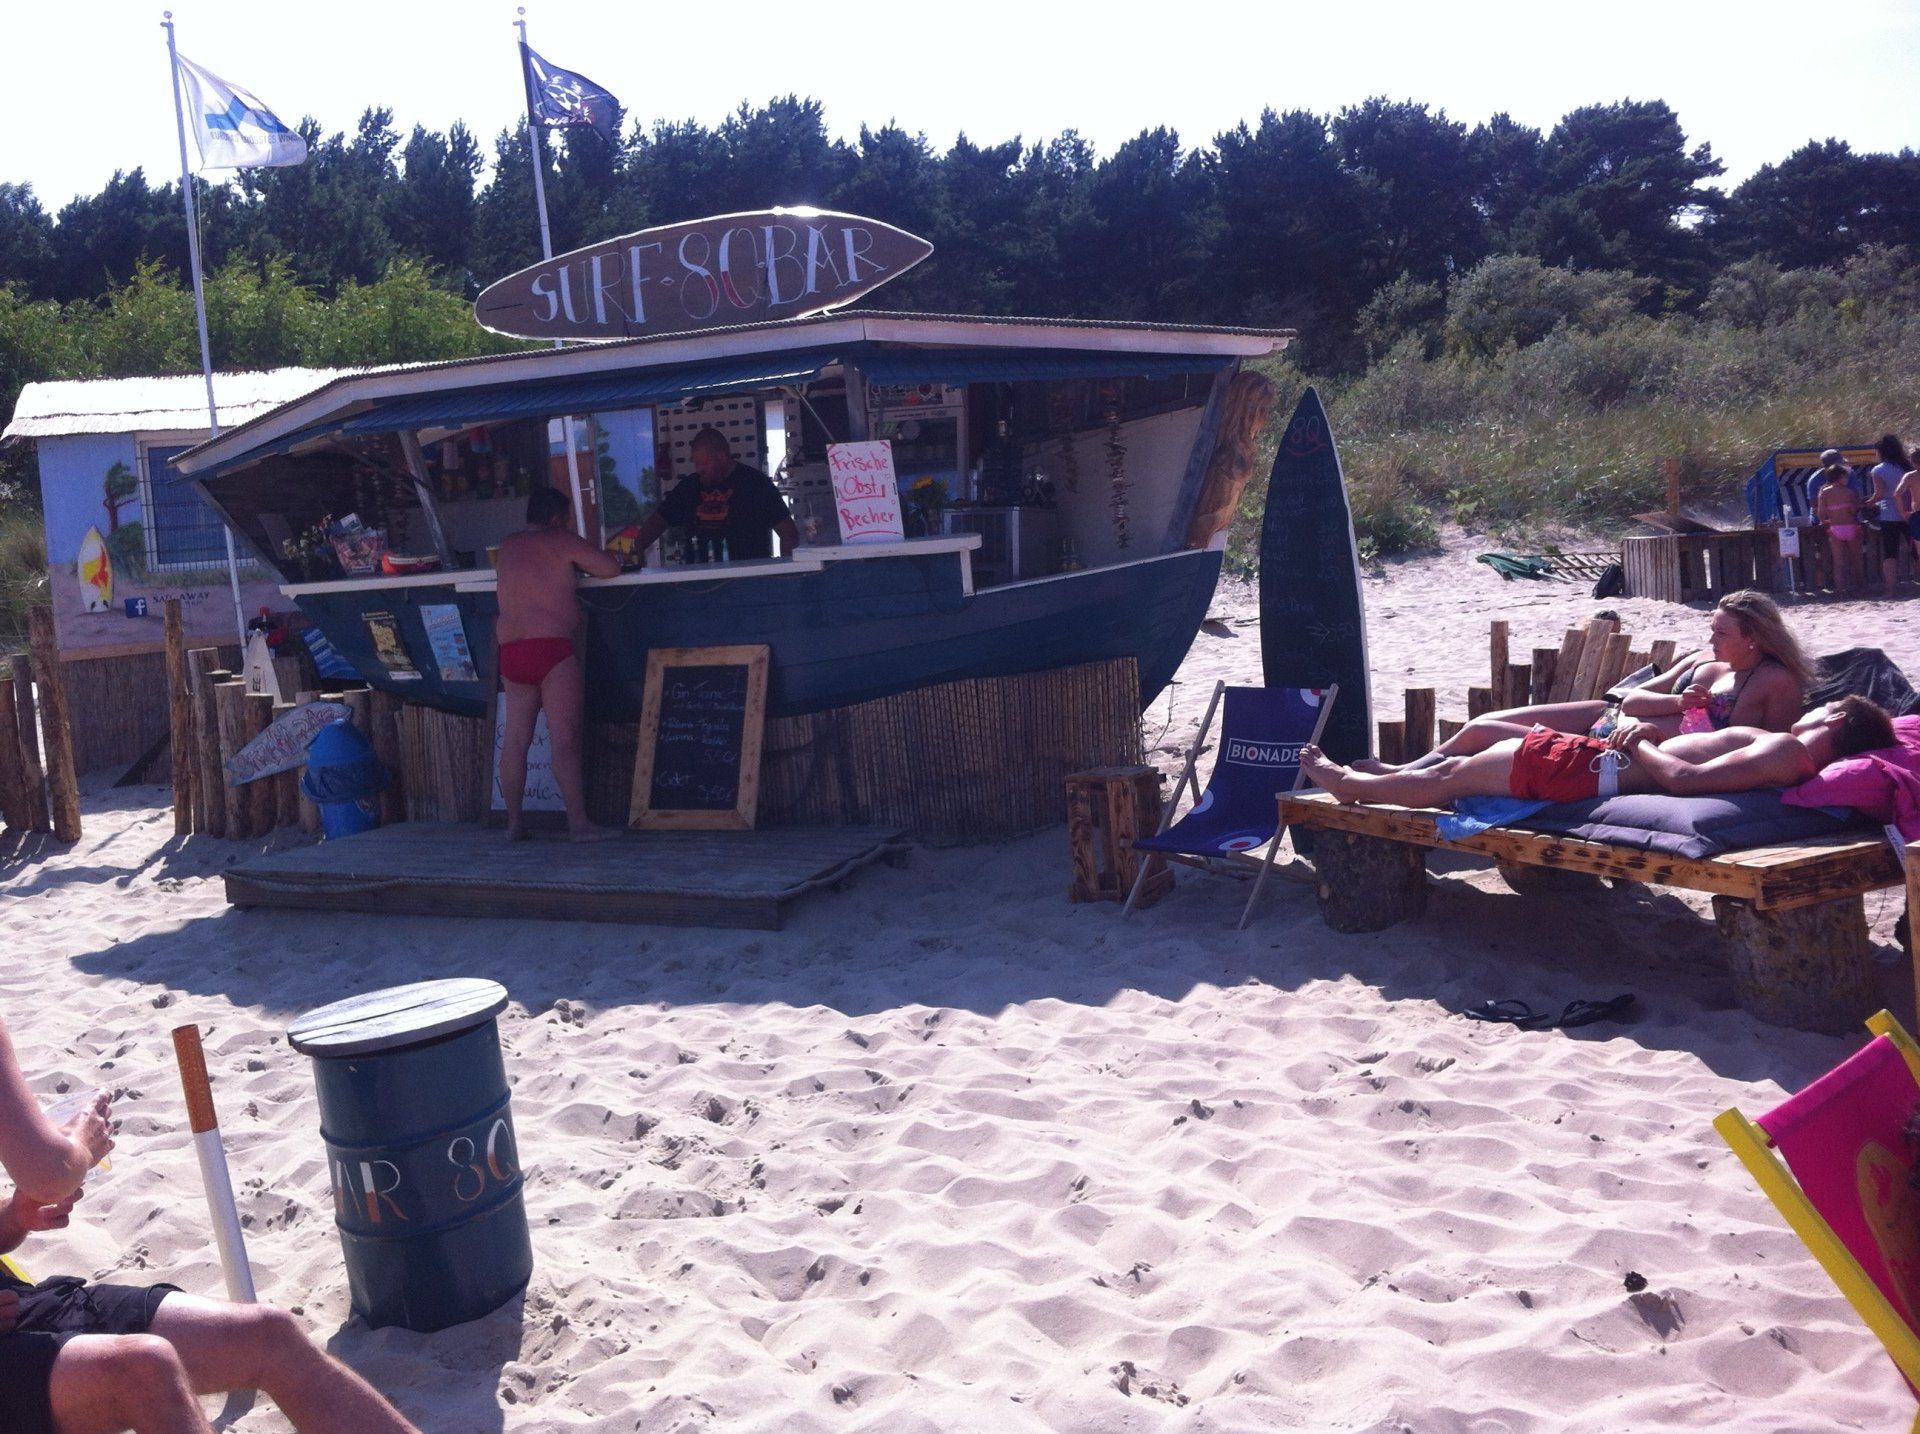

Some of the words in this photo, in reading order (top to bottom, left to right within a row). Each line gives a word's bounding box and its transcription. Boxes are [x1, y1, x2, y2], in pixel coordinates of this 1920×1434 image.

[531, 241, 662, 325] SURF
[830, 450, 888, 471] Frische
[843, 474, 877, 495] Obst
[840, 506, 895, 531] Becher
[180, 591, 210, 601] AWAY
[1230, 744, 1301, 763] BIONADE
